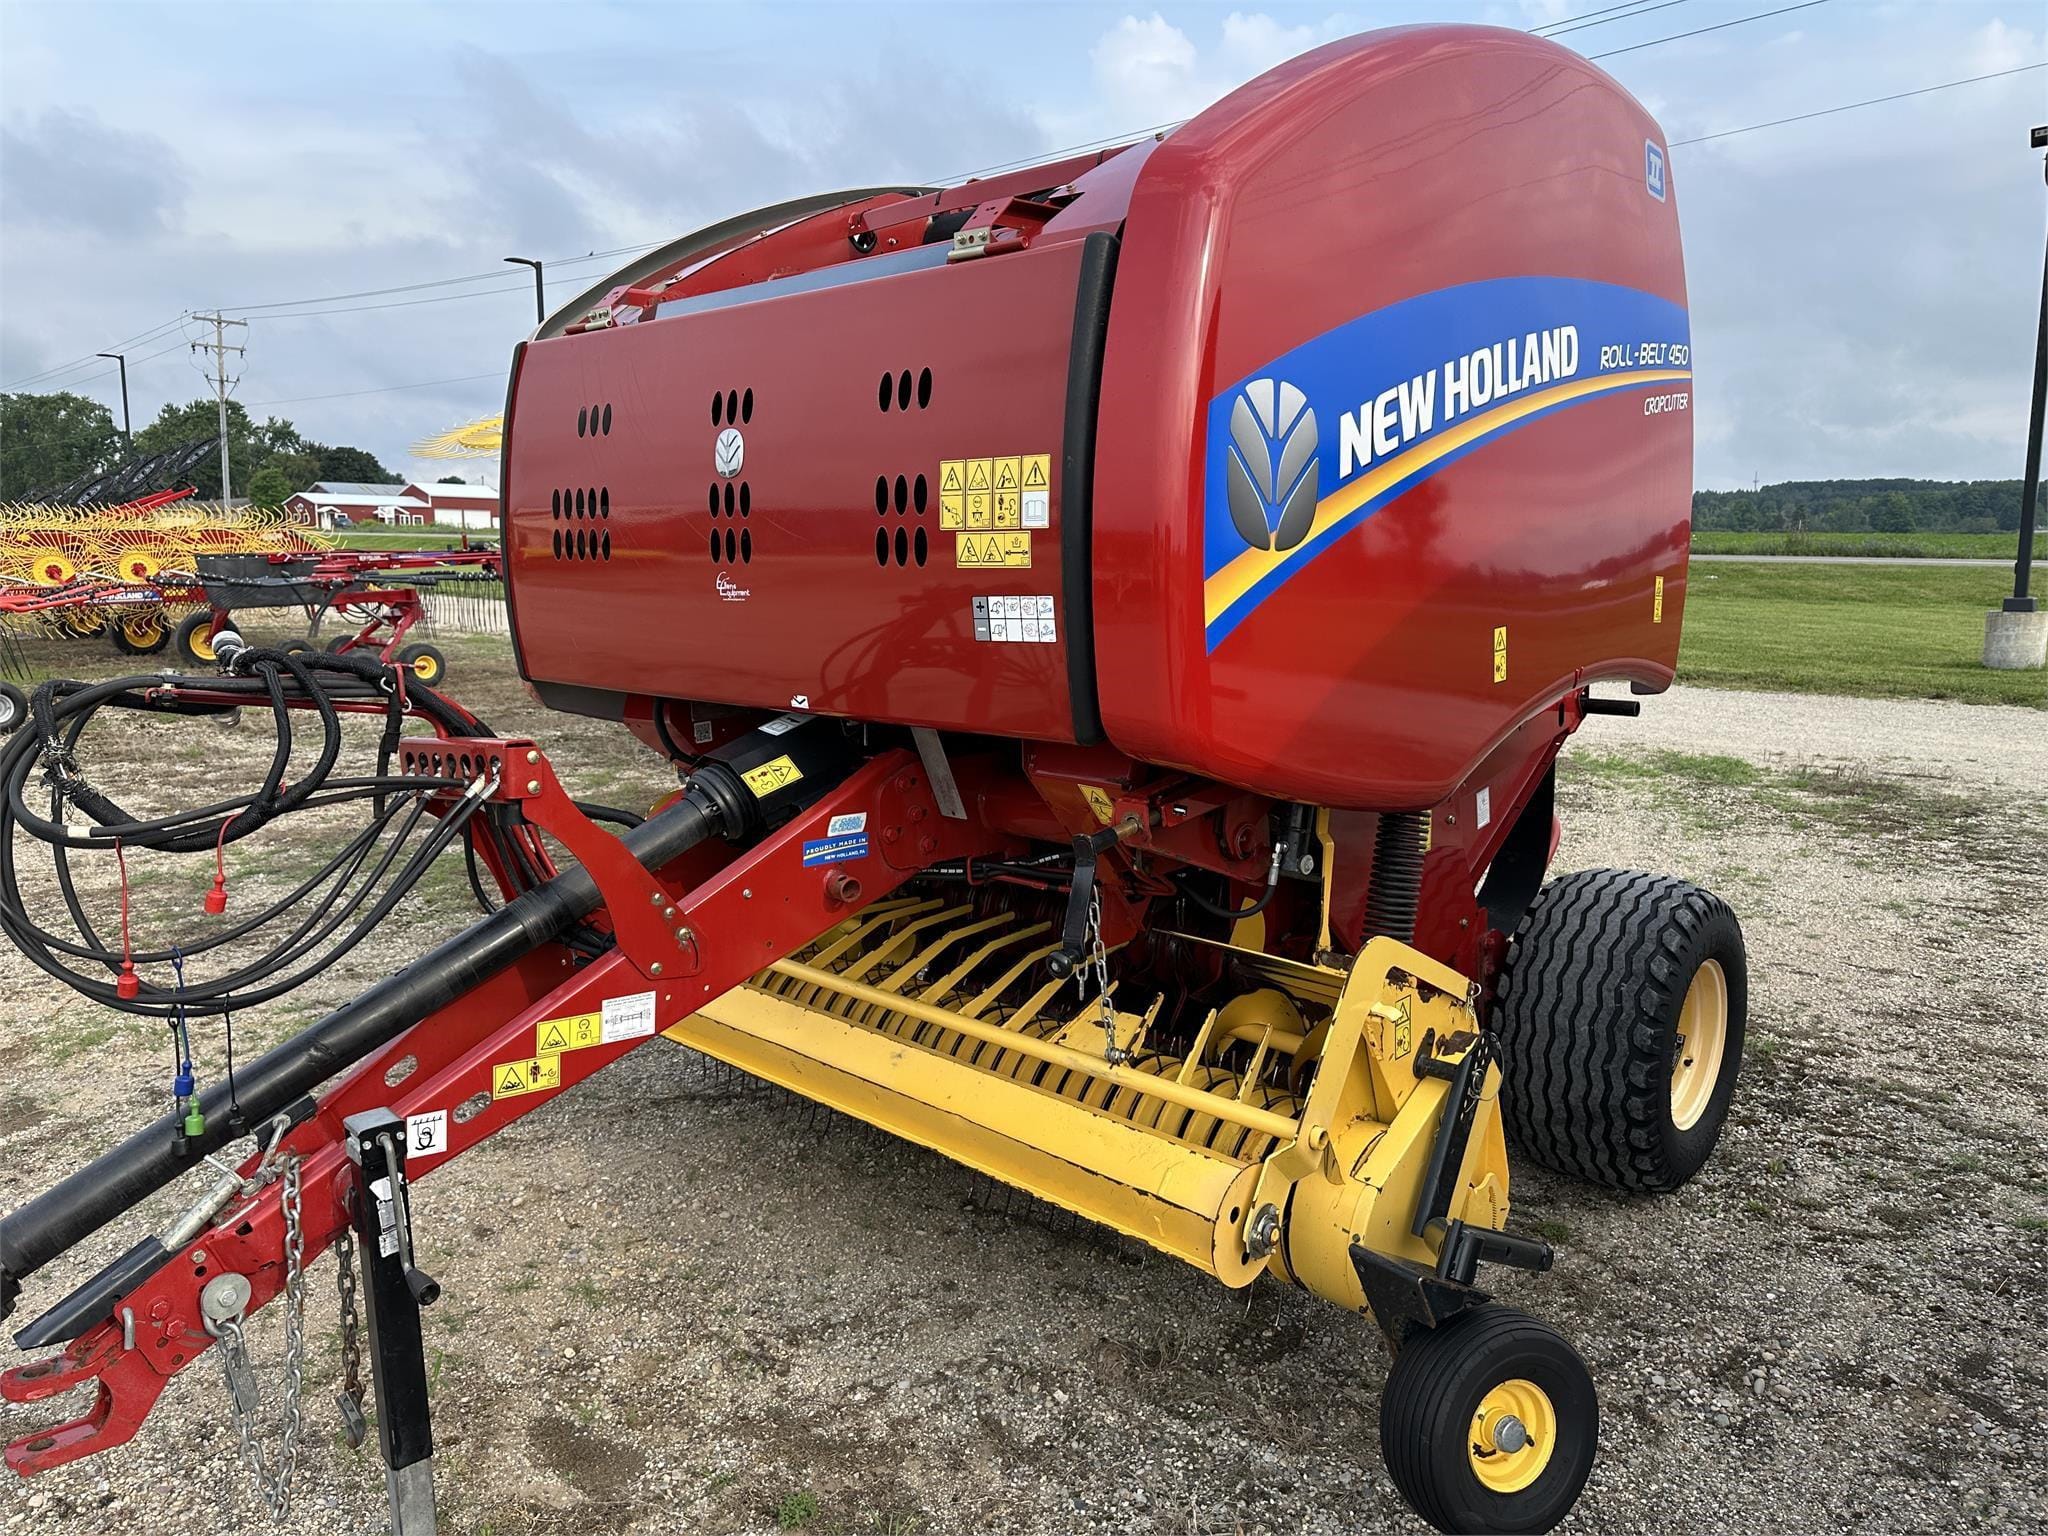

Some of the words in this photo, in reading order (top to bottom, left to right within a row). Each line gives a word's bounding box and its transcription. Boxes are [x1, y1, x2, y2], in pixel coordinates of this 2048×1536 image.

[1600, 343, 1667, 370] ROLL-BELT
[1668, 344, 1689, 365] 450
[1339, 368, 1437, 480] NEW
[1444, 325, 1579, 422] HOLLAND
[1644, 393, 1688, 416] CROPCUTTER
[806, 843, 836, 855] PROUDLY
